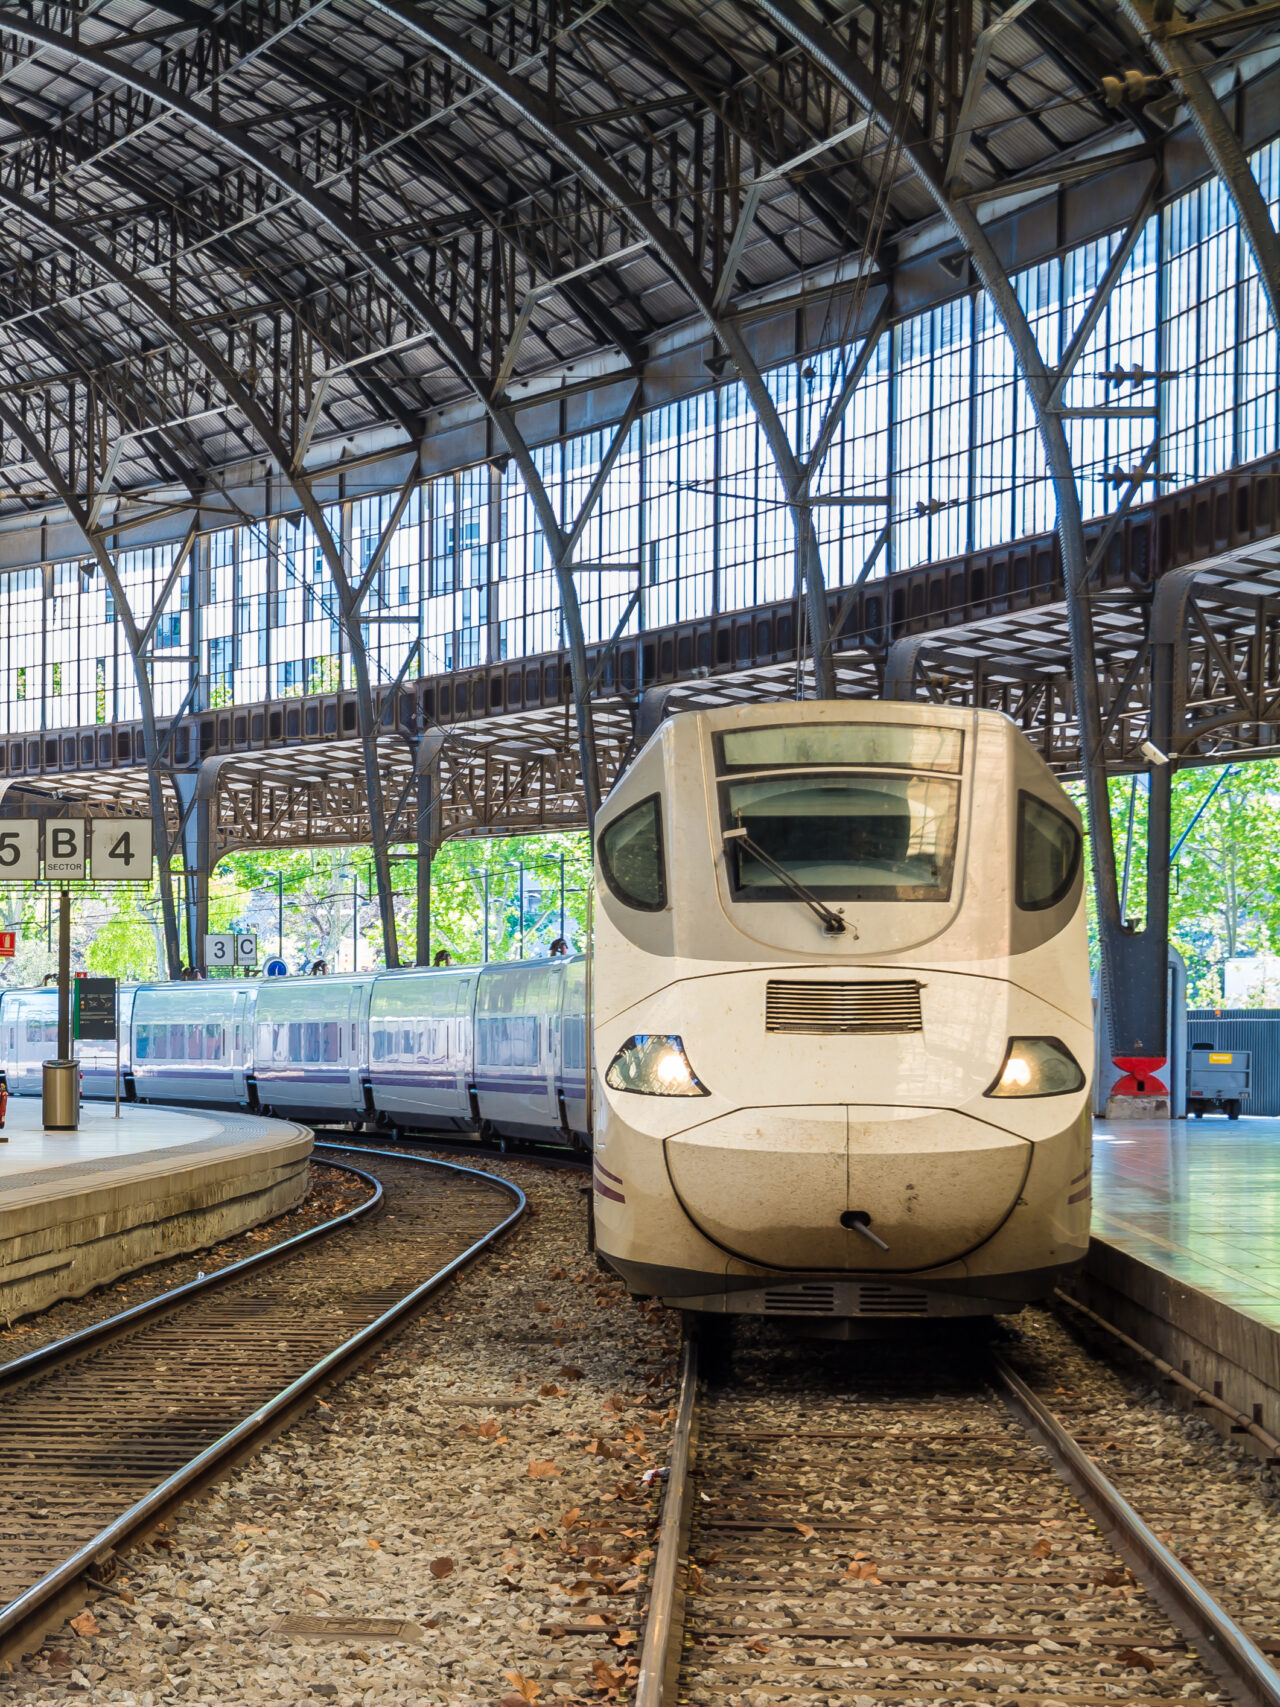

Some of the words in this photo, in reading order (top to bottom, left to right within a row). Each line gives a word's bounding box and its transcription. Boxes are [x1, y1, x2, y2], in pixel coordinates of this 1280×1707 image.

[52, 828, 78, 859] B
[108, 831, 136, 867] 4
[47, 863, 82, 871] SECTOR
[214, 941, 226, 959] 3
[240, 938, 254, 955] C
